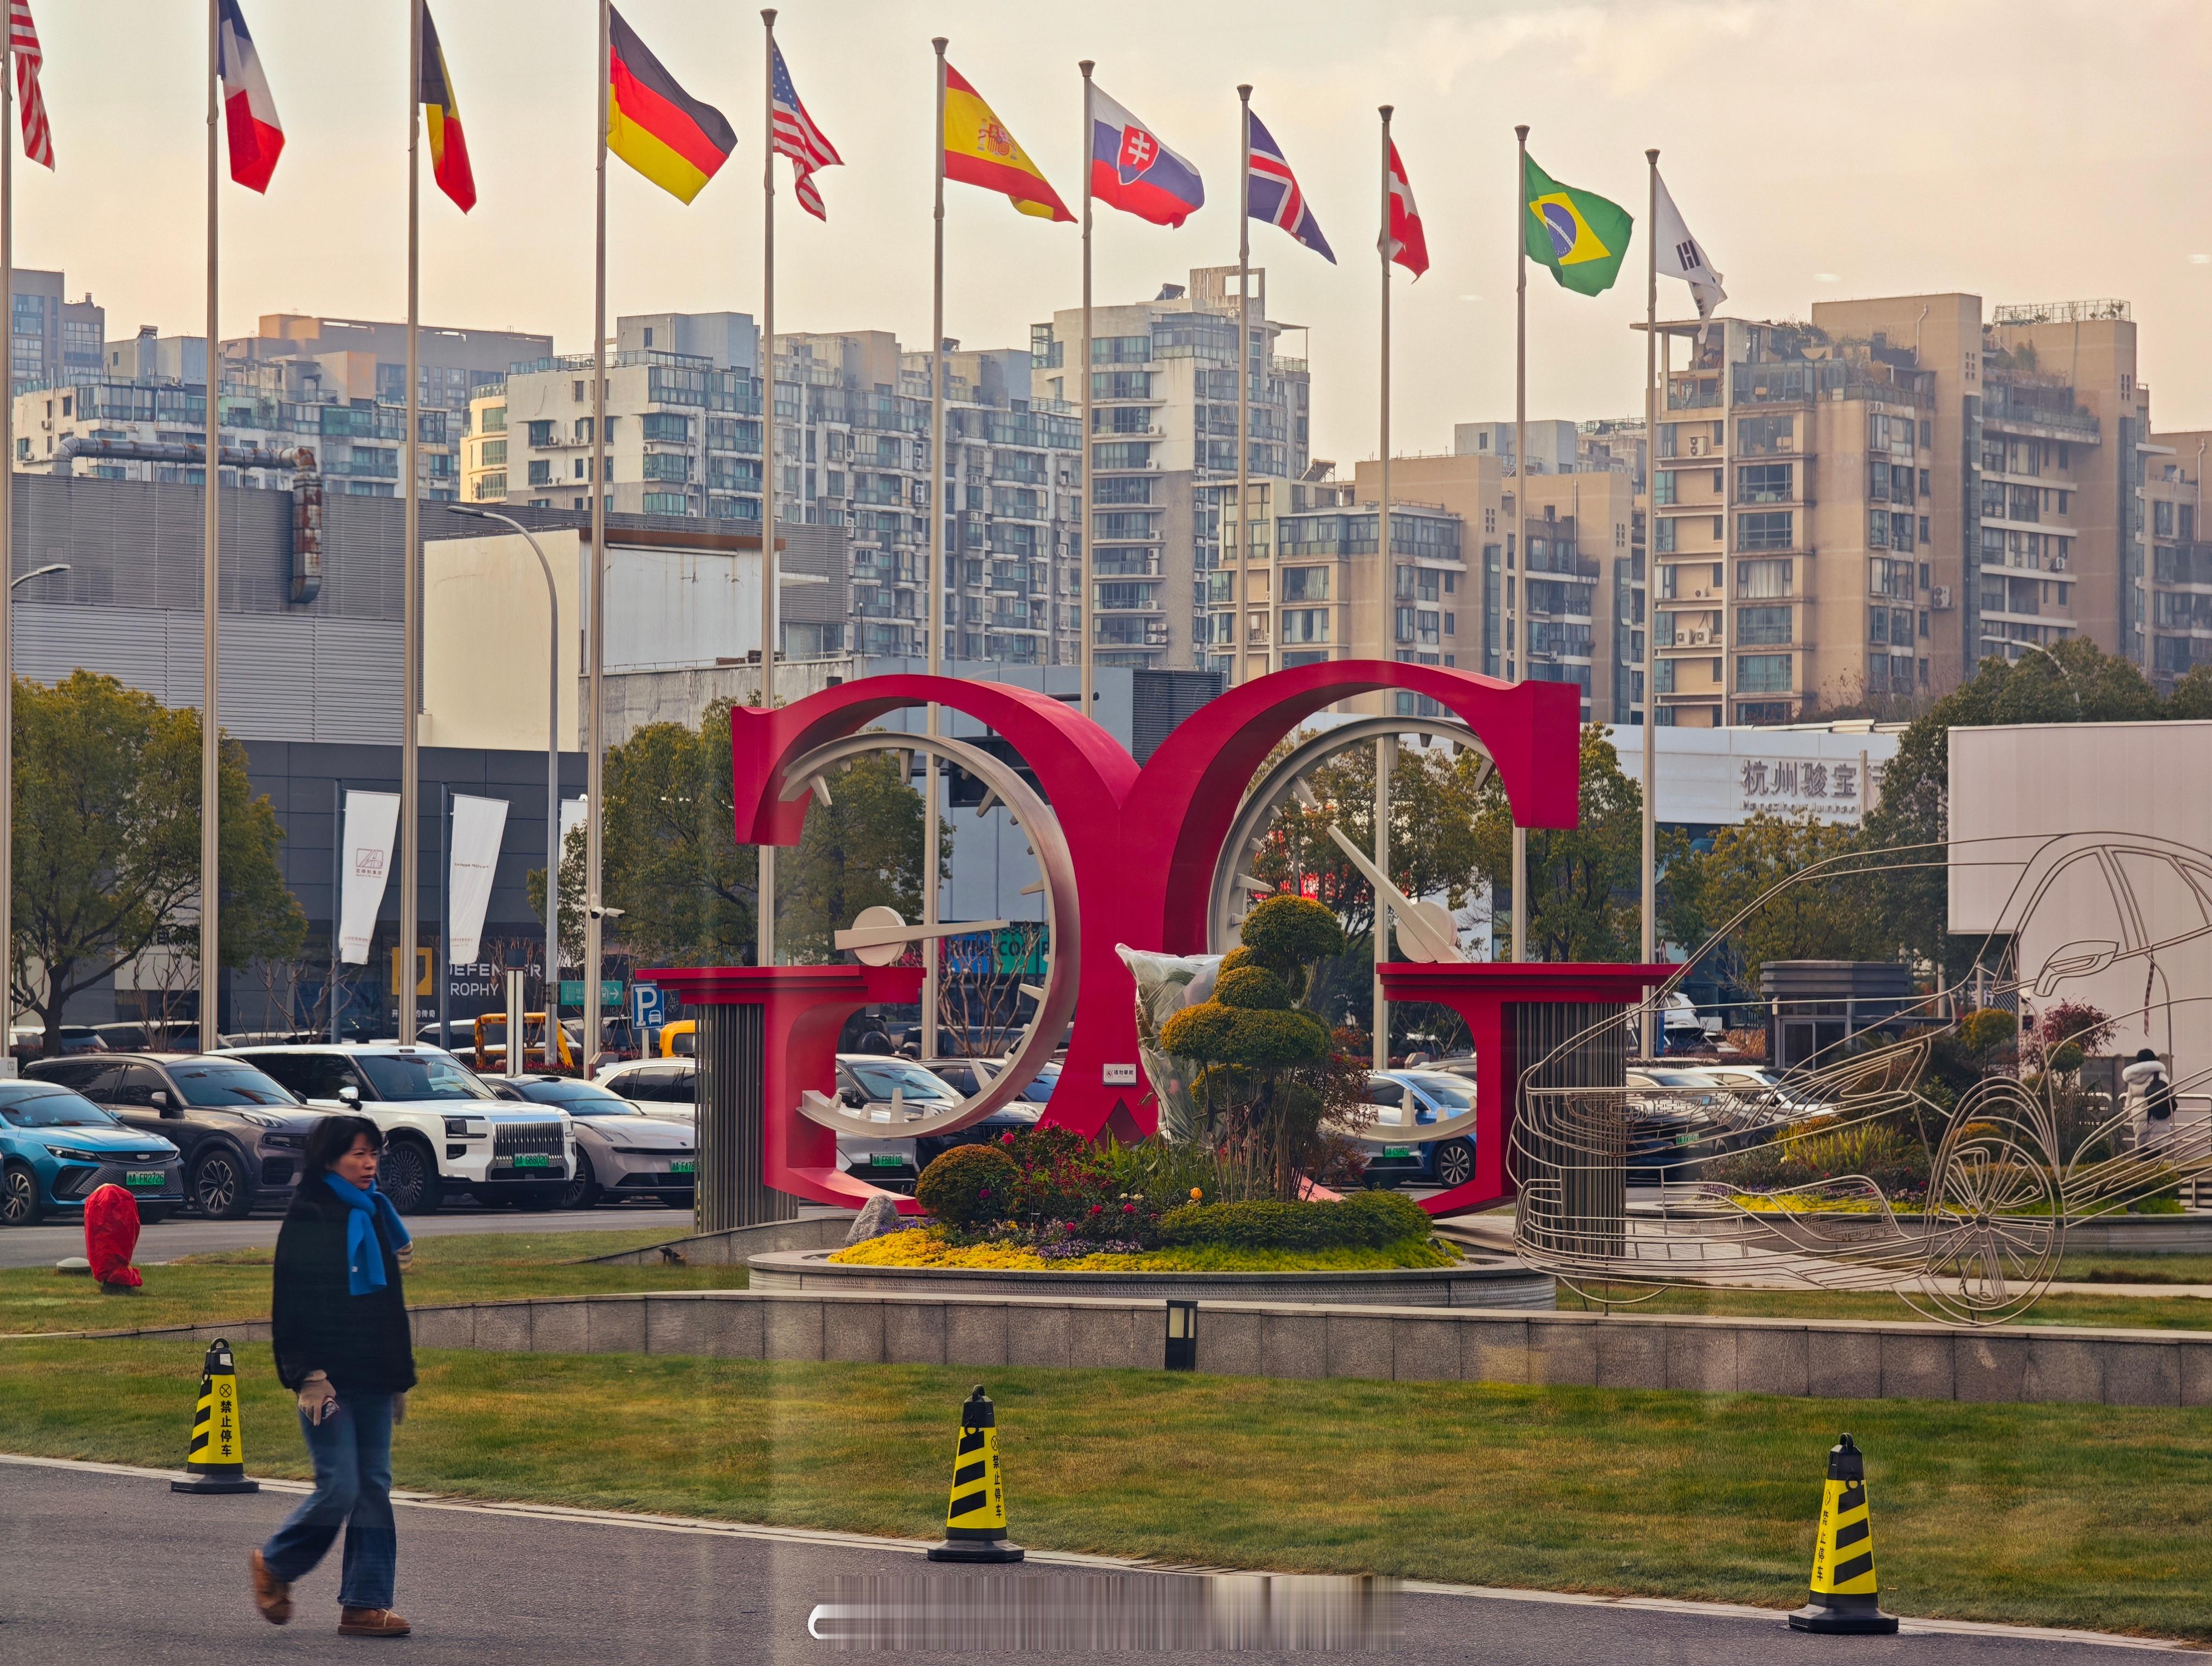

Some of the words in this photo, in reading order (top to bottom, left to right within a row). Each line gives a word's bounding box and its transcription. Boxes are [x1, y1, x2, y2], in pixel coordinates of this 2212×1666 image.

[449, 963, 542, 977] EFENR
[450, 983, 499, 996] ROPHY
[635, 986, 658, 1027] P
[220, 1400, 232, 1457] 禁止停车
[993, 1454, 1001, 1518] 禁止停车
[1817, 1510, 1829, 1582] 禁止停车
